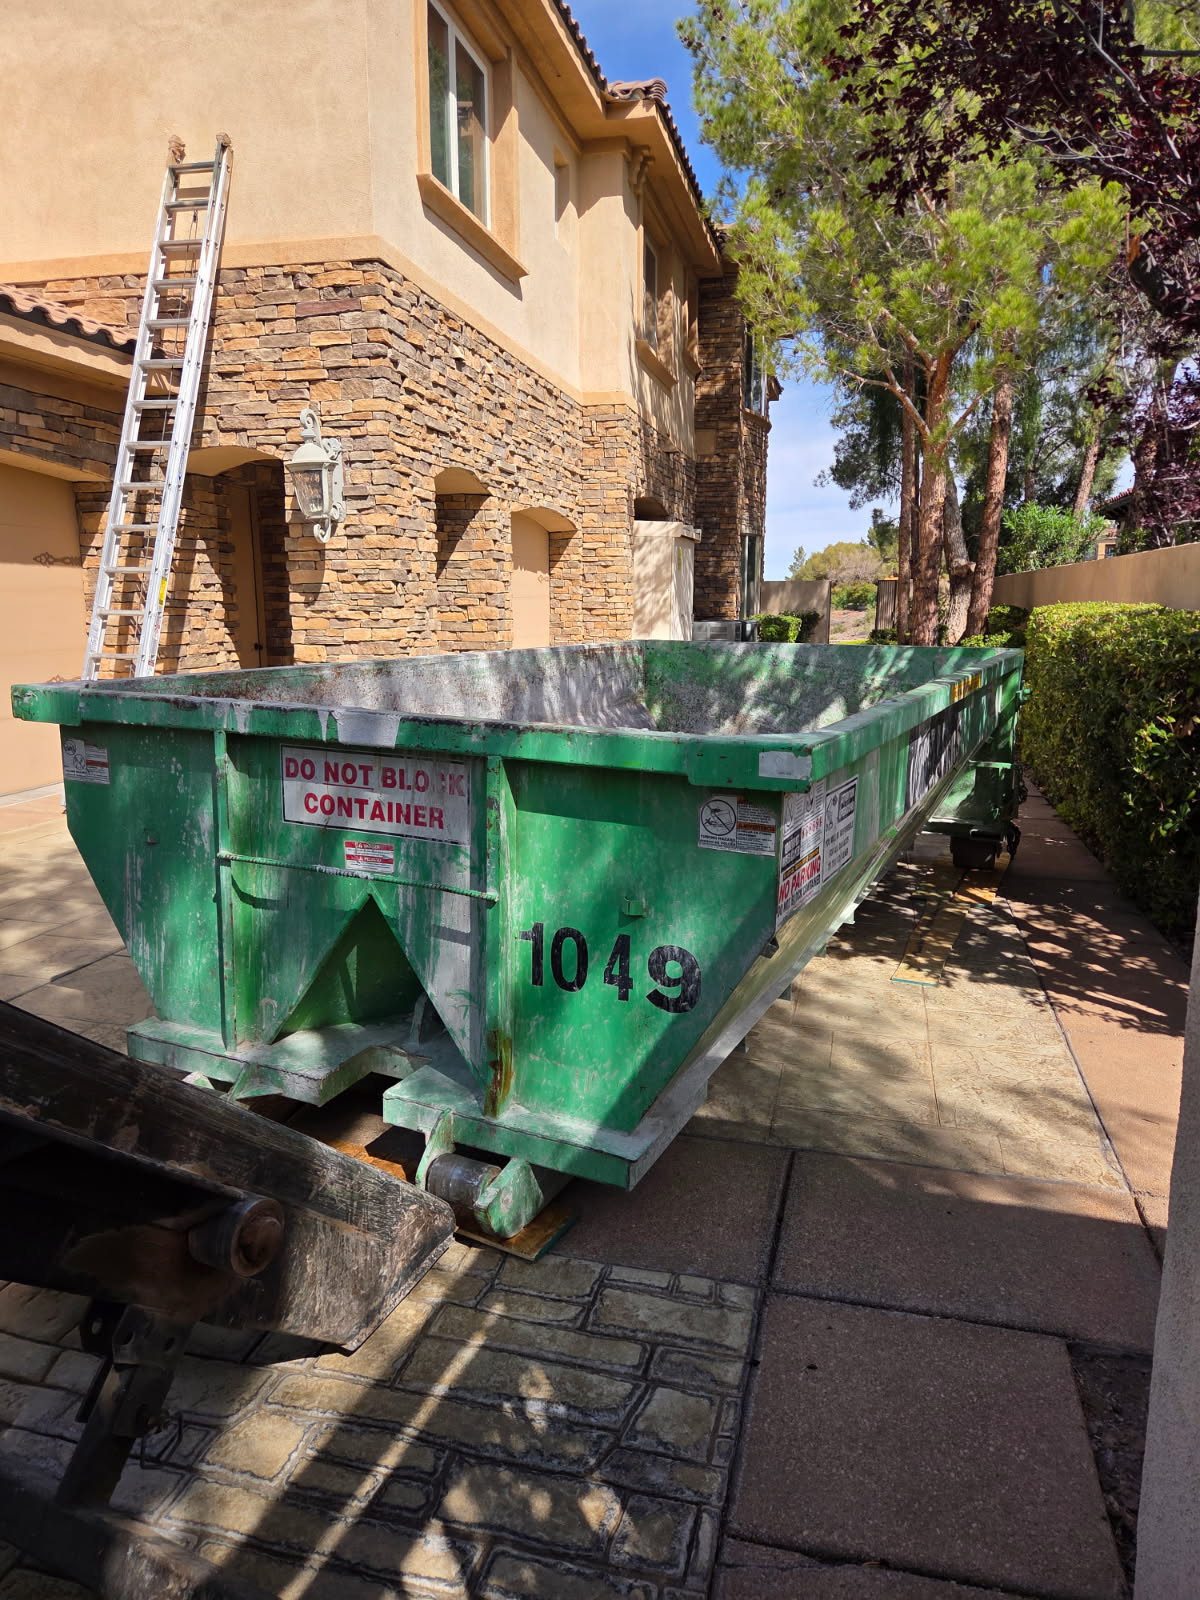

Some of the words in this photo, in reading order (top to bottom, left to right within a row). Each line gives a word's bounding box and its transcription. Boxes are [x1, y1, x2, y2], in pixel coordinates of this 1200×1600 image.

[285, 757, 316, 780] DO
[324, 761, 373, 786] NOT
[382, 767, 465, 797] BLOK
[304, 792, 444, 829] CONTAINER
[778, 879, 790, 904] NO
[791, 855, 821, 895] PARKING
[519, 922, 702, 1014] 1049
